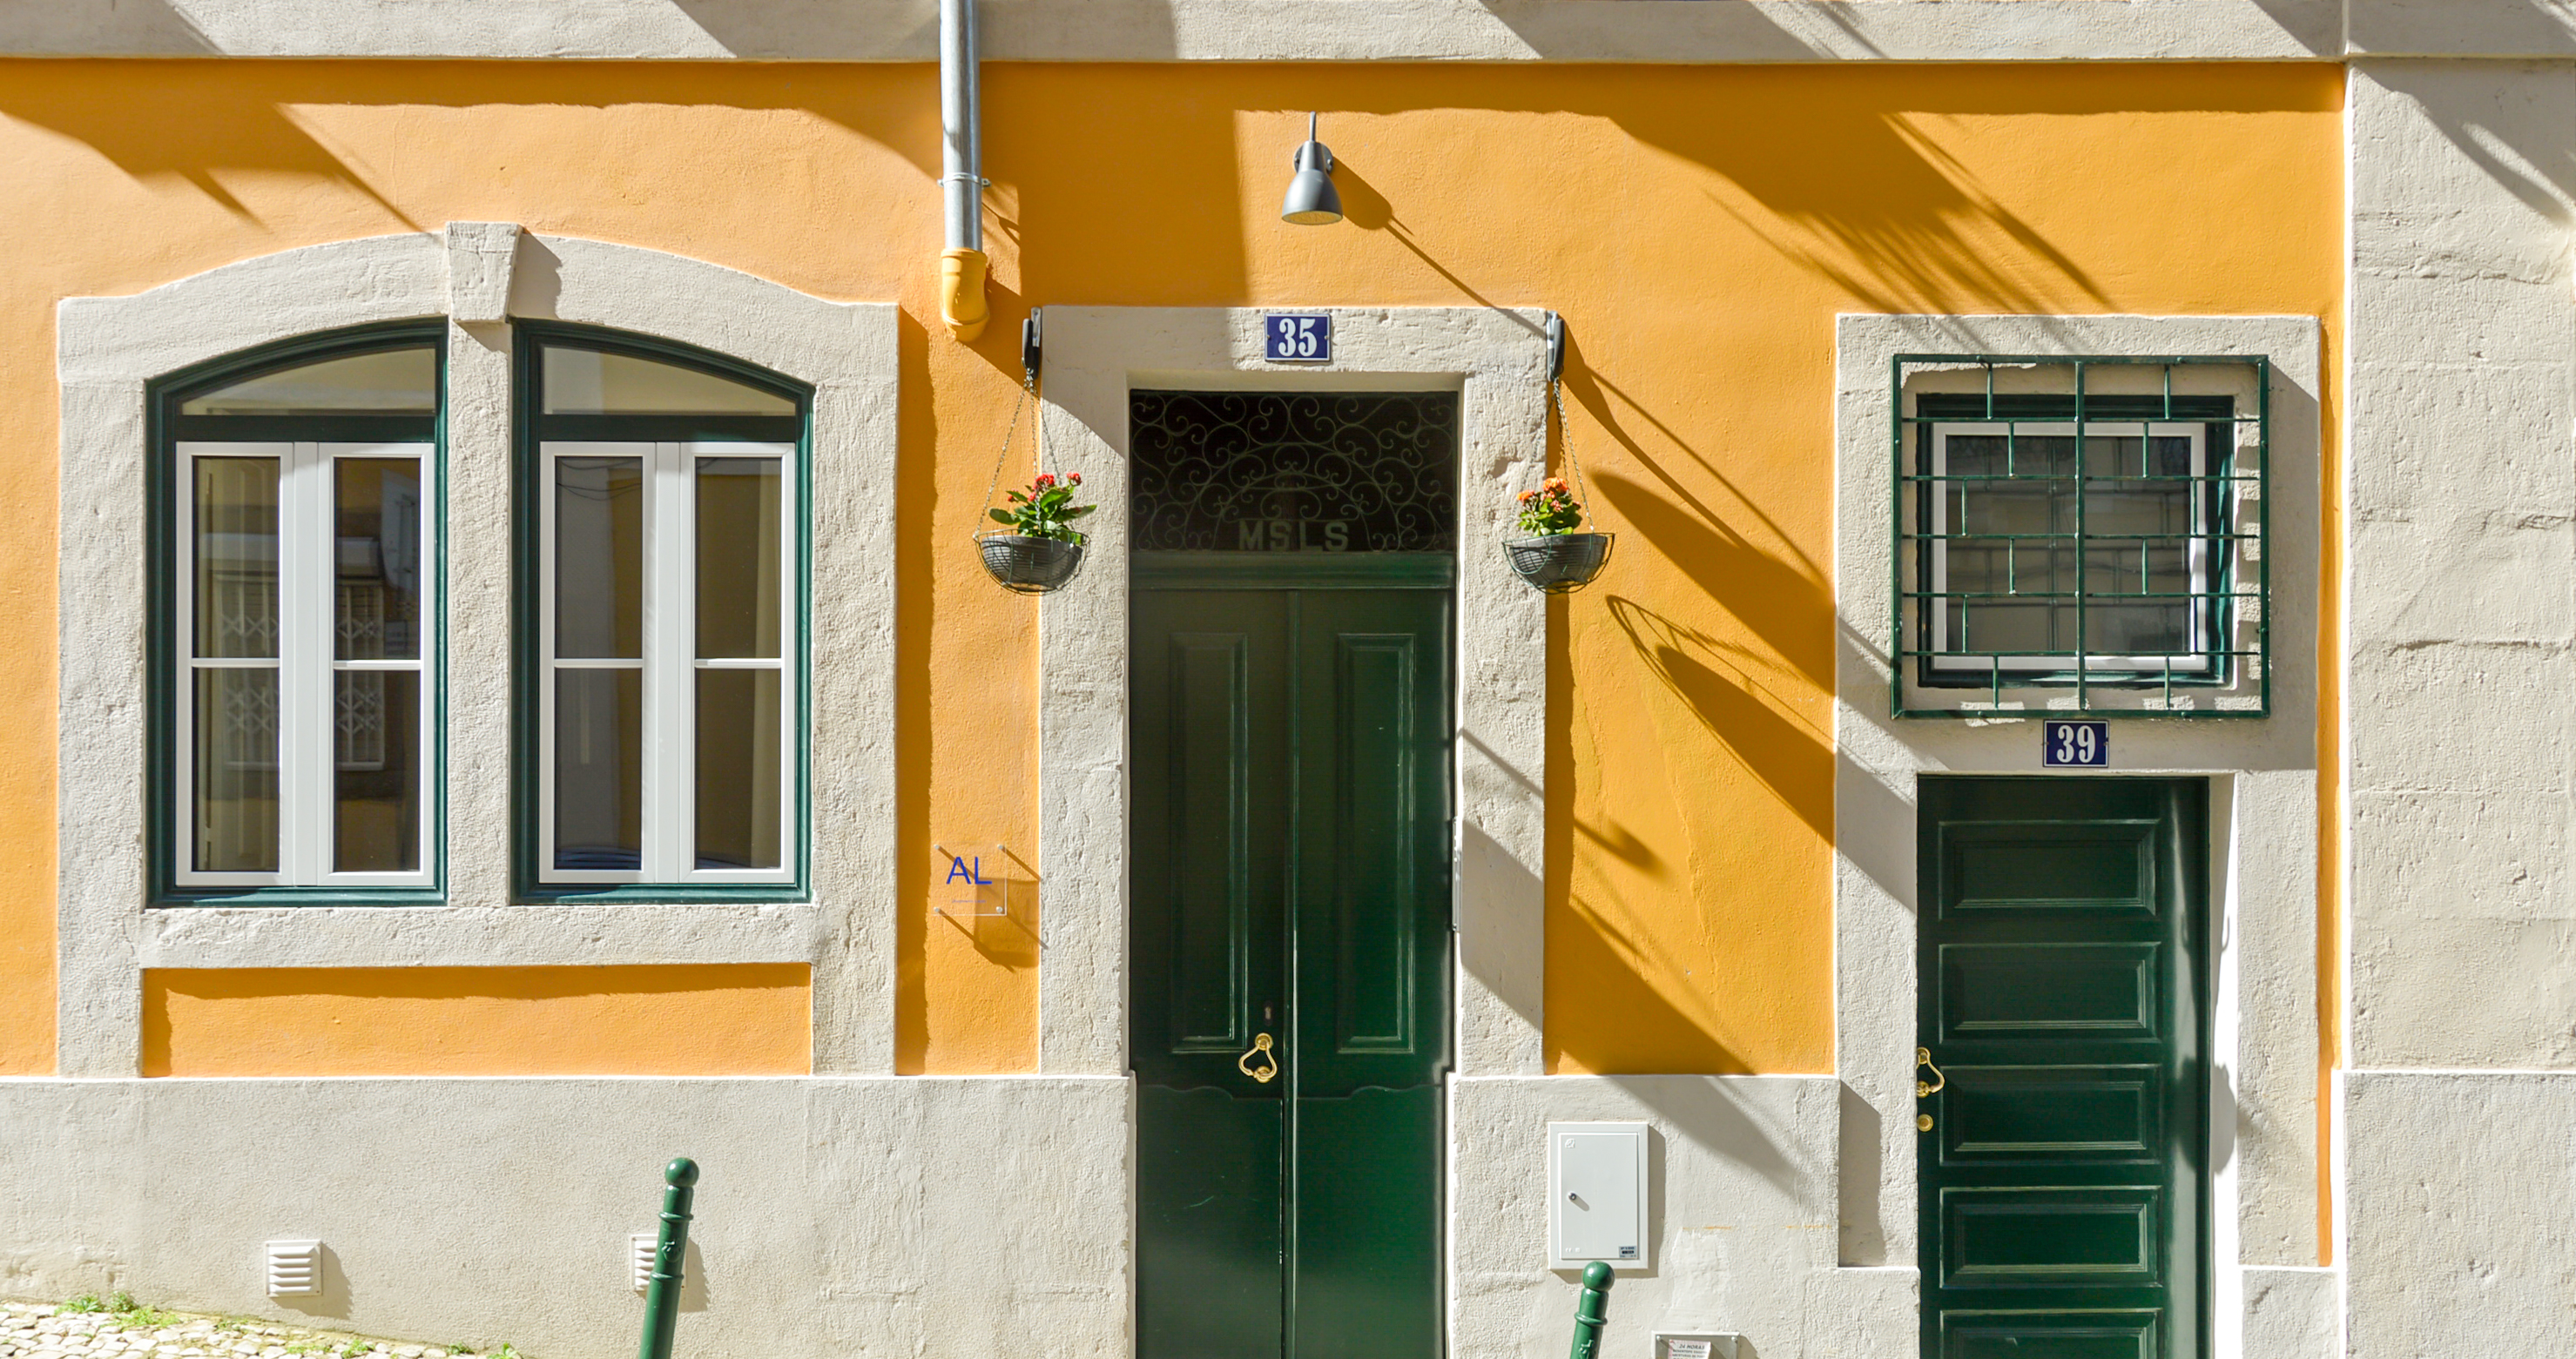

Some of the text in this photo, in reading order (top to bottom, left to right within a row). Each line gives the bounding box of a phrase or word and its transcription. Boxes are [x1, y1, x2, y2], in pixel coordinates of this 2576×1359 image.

[1278, 318, 1317, 357] 35
[1239, 520, 1349, 551] MSLS
[2056, 724, 2096, 764] 39
[946, 856, 993, 885] AL
